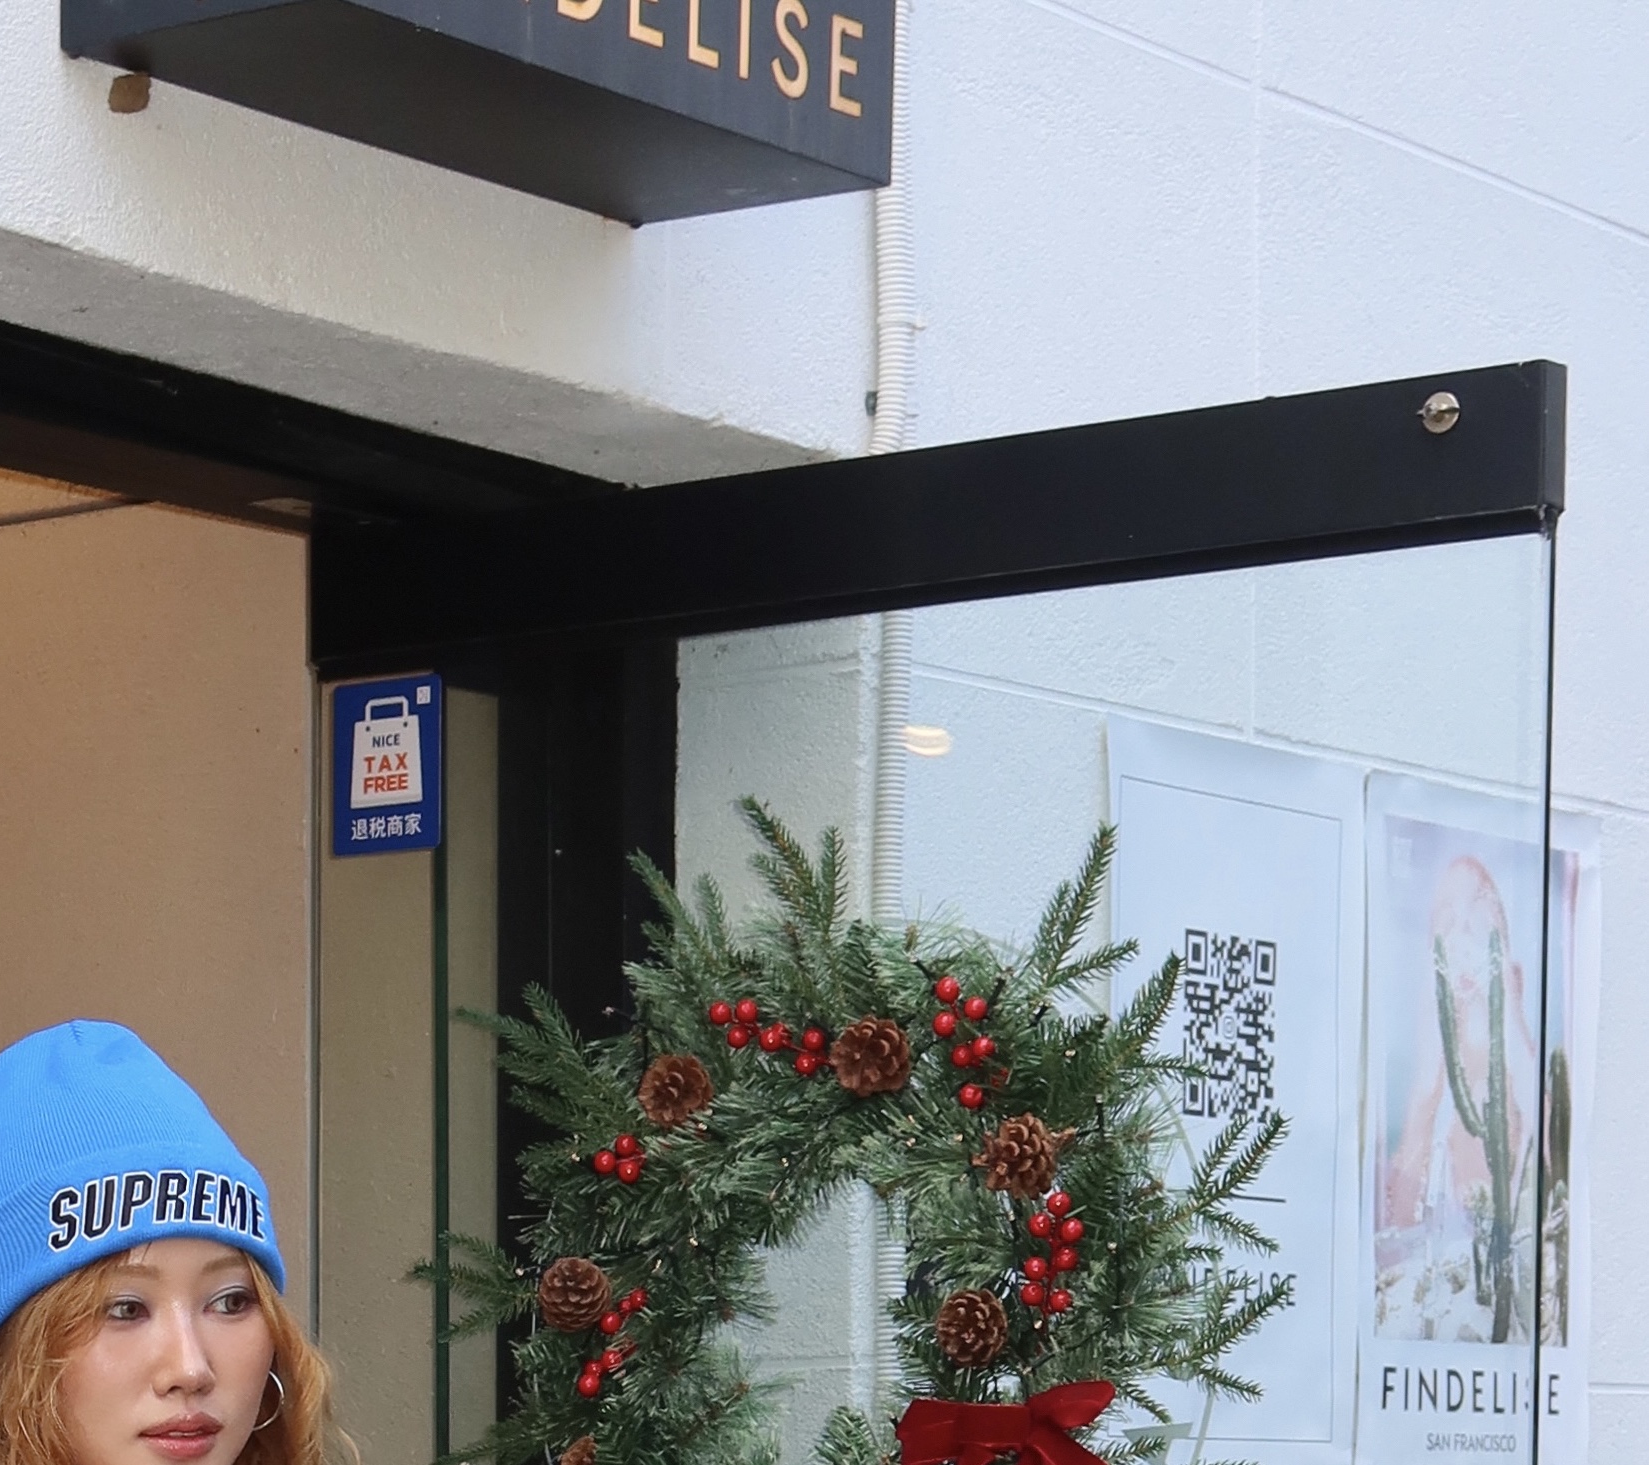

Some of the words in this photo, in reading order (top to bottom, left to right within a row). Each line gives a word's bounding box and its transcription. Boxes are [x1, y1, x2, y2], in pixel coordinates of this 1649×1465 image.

[372, 733, 401, 748] NICE
[363, 752, 408, 774] TAX
[363, 773, 409, 794] FREE
[351, 813, 421, 840] 退税商家
[48, 1169, 266, 1251] SUPREME
[1381, 1366, 1561, 1416] FINDELIE
[1426, 1432, 1451, 1452] SAN
[1453, 1433, 1516, 1454] FRANCISCO
